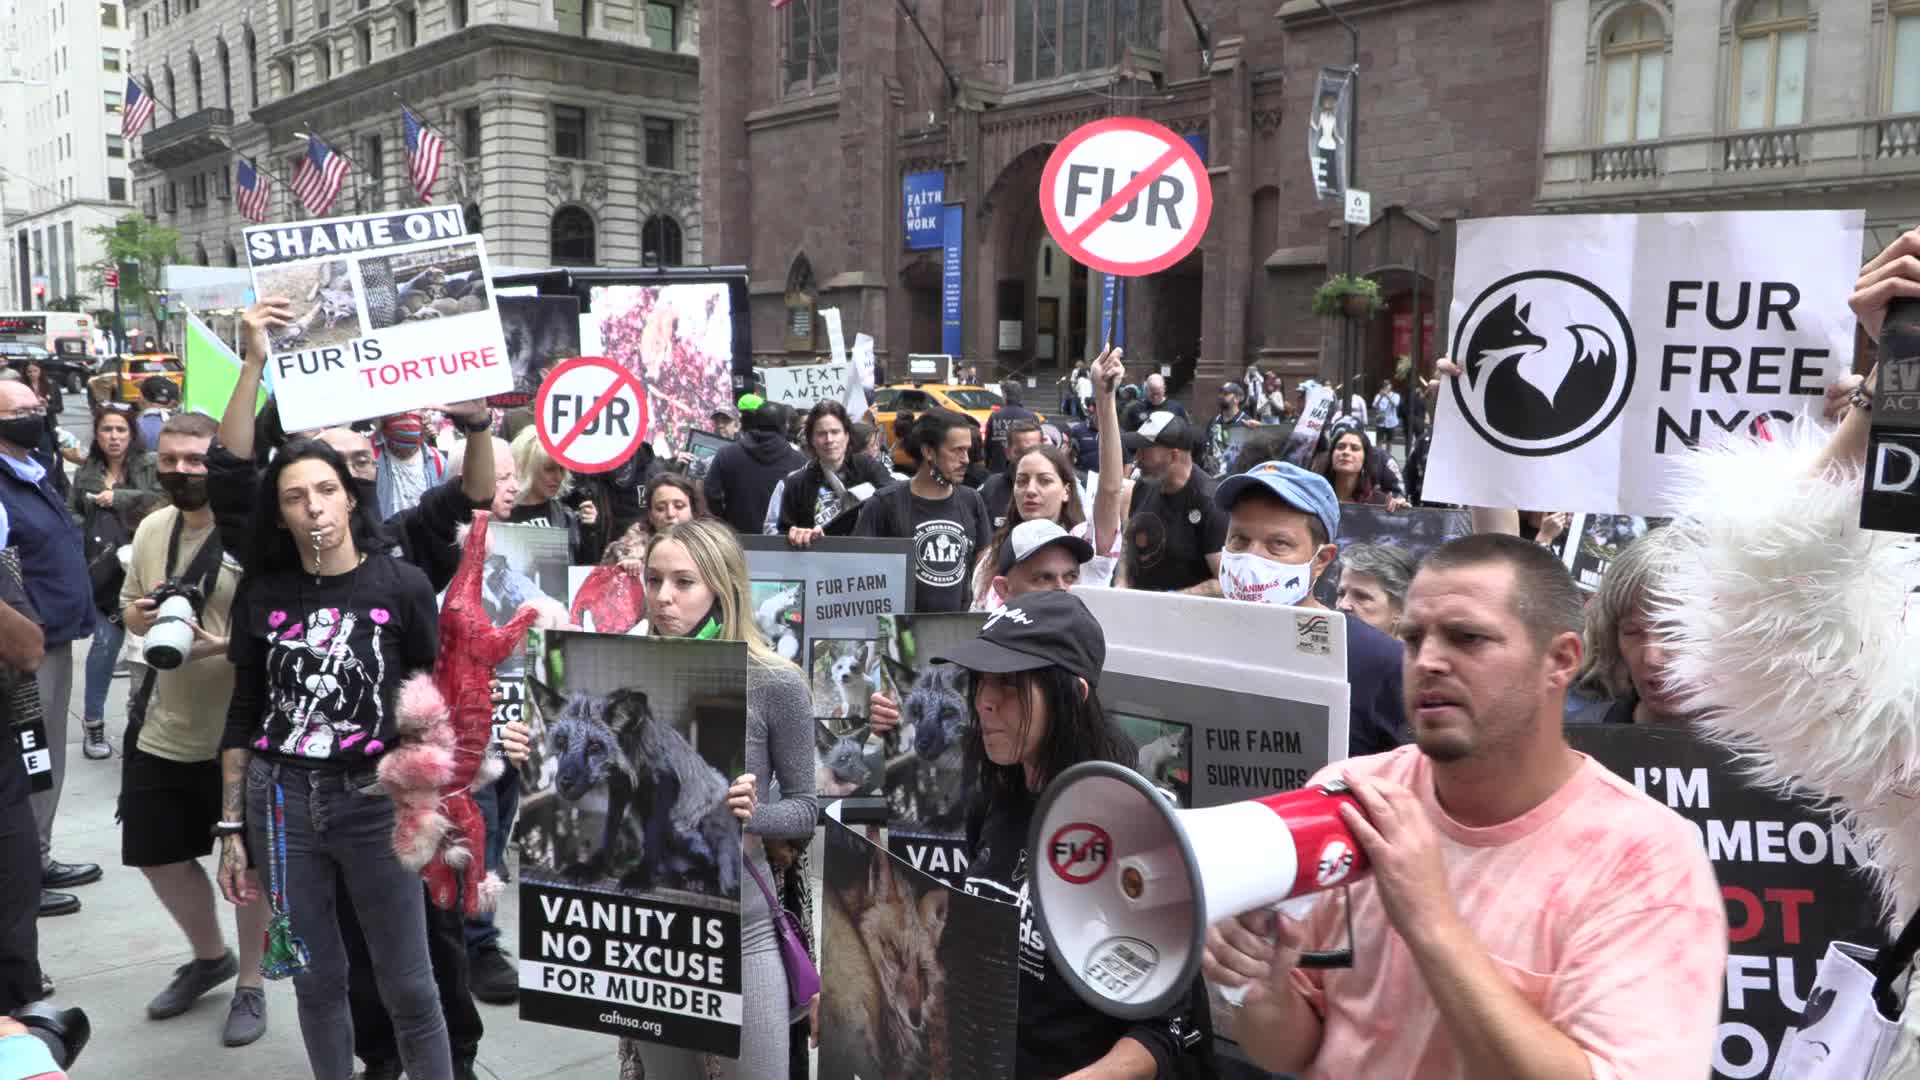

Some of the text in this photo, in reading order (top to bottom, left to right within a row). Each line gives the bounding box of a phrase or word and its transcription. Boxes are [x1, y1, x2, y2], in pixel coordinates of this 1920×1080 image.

[907, 190, 942, 206] FAITH
[907, 206, 921, 218] AT
[1064, 164, 1185, 230] FUR
[250, 209, 462, 260] SHAME ON
[907, 217, 937, 232] WORK
[1666, 281, 1800, 331] FUR
[278, 339, 383, 378] FUR IS
[360, 347, 498, 388] TORTURE
[788, 367, 845, 385] TEXT
[1660, 345, 1830, 395] FREE
[782, 384, 846, 401] ANIMA
[551, 394, 630, 437] FUR
[816, 574, 887, 596] FUR FARM
[816, 597, 892, 620] SURVIVORS
[1206, 728, 1303, 754] FUR FARM
[1206, 764, 1308, 790] SURVIVORS
[1633, 767, 1711, 809] I'M
[540, 895, 724, 949] VANITY IS
[1720, 886, 1815, 945] OT
[542, 931, 724, 985] NO EXCUSE
[543, 966, 723, 1018] FOR MURDER
[599, 1010, 663, 1036] caftusa.org
